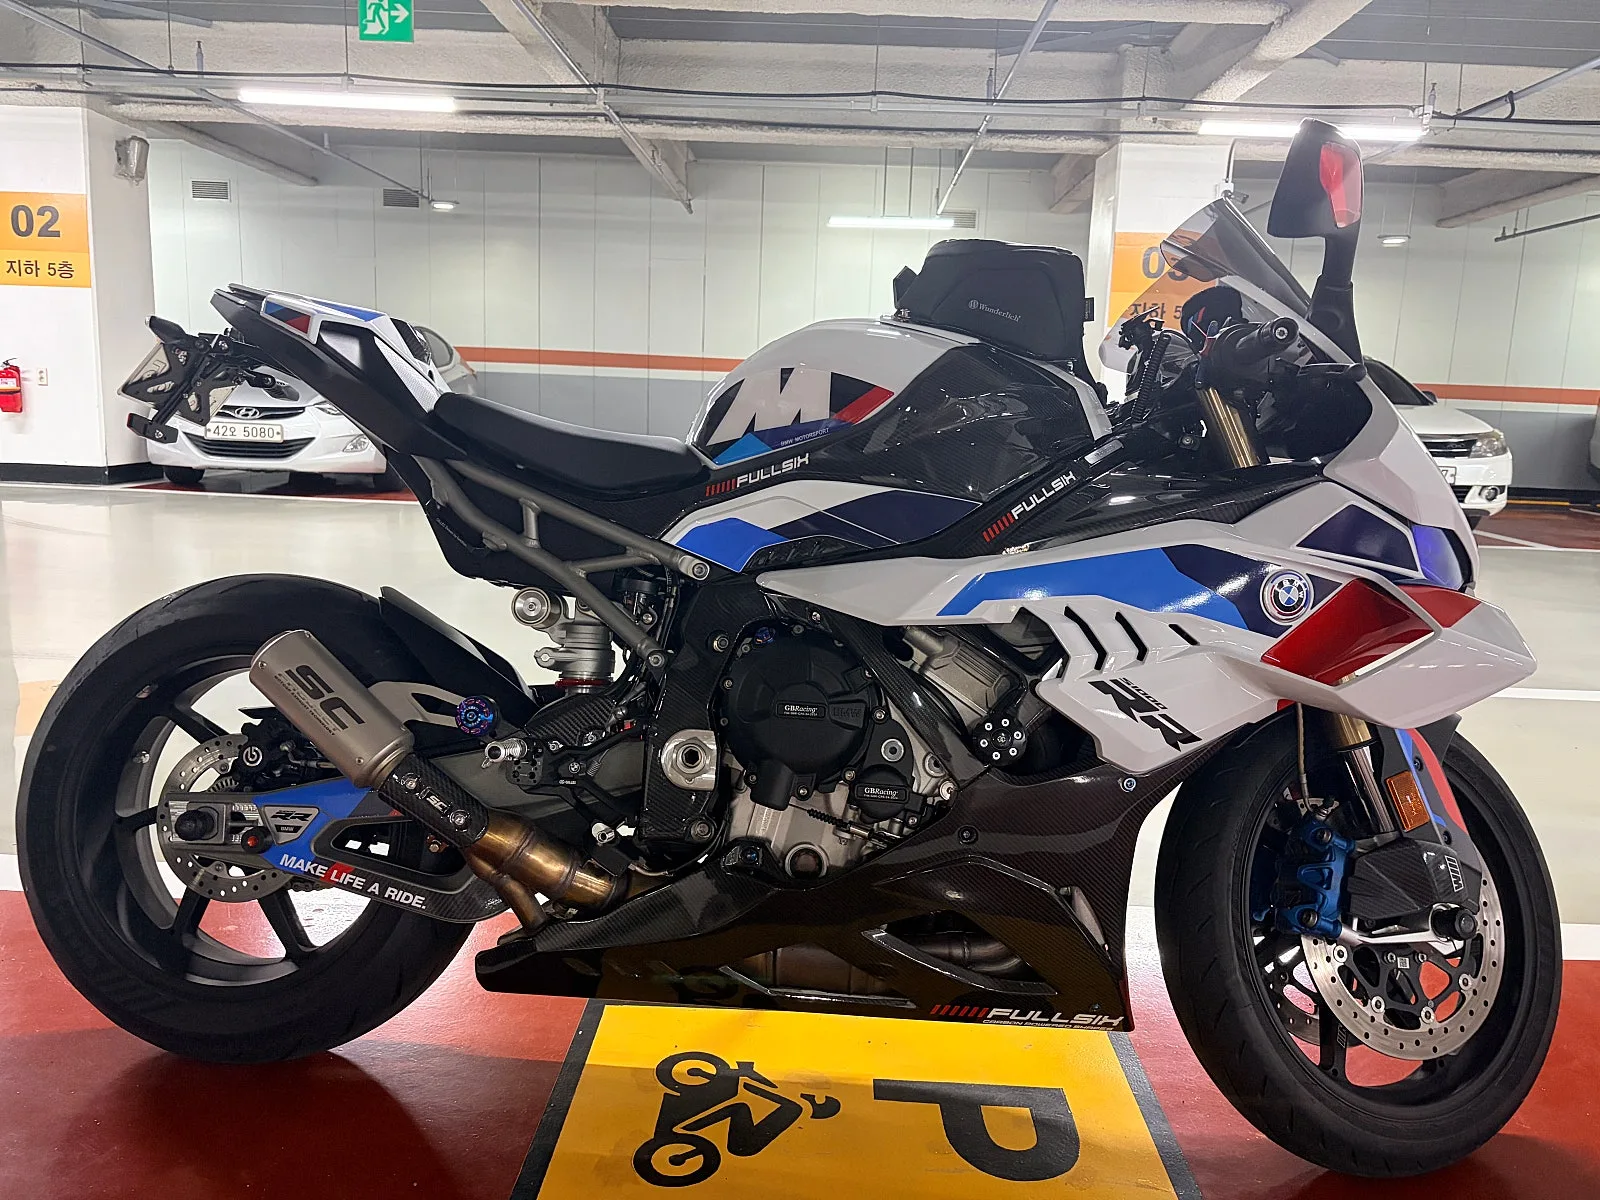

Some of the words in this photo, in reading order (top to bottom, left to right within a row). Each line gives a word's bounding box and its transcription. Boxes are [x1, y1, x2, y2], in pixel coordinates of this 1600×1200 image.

[11, 204, 61, 237] 02
[6, 259, 40, 277] 지하
[47, 260, 75, 279] 5층
[979, 303, 1020, 322] Wunderlich
[213, 425, 237, 437] 42오
[243, 426, 275, 439] 5080
[780, 438, 793, 446] BMW
[794, 427, 830, 442] MOTORSPORT
[736, 452, 810, 488] FULLSIX
[1011, 470, 1077, 520] FULLSIX
[284, 664, 366, 731] SC
[784, 704, 818, 713] GBRacing
[1118, 677, 1168, 710] S1000
[1088, 679, 1203, 752] RR
[864, 787, 899, 797] GBRacing
[279, 853, 329, 878] MAKE
[330, 869, 366, 890] LIFE
[367, 882, 380, 895] A
[384, 886, 427, 909] RIDE.
[986, 1007, 1125, 1027] FULLSIX
[873, 1079, 1081, 1182] P
